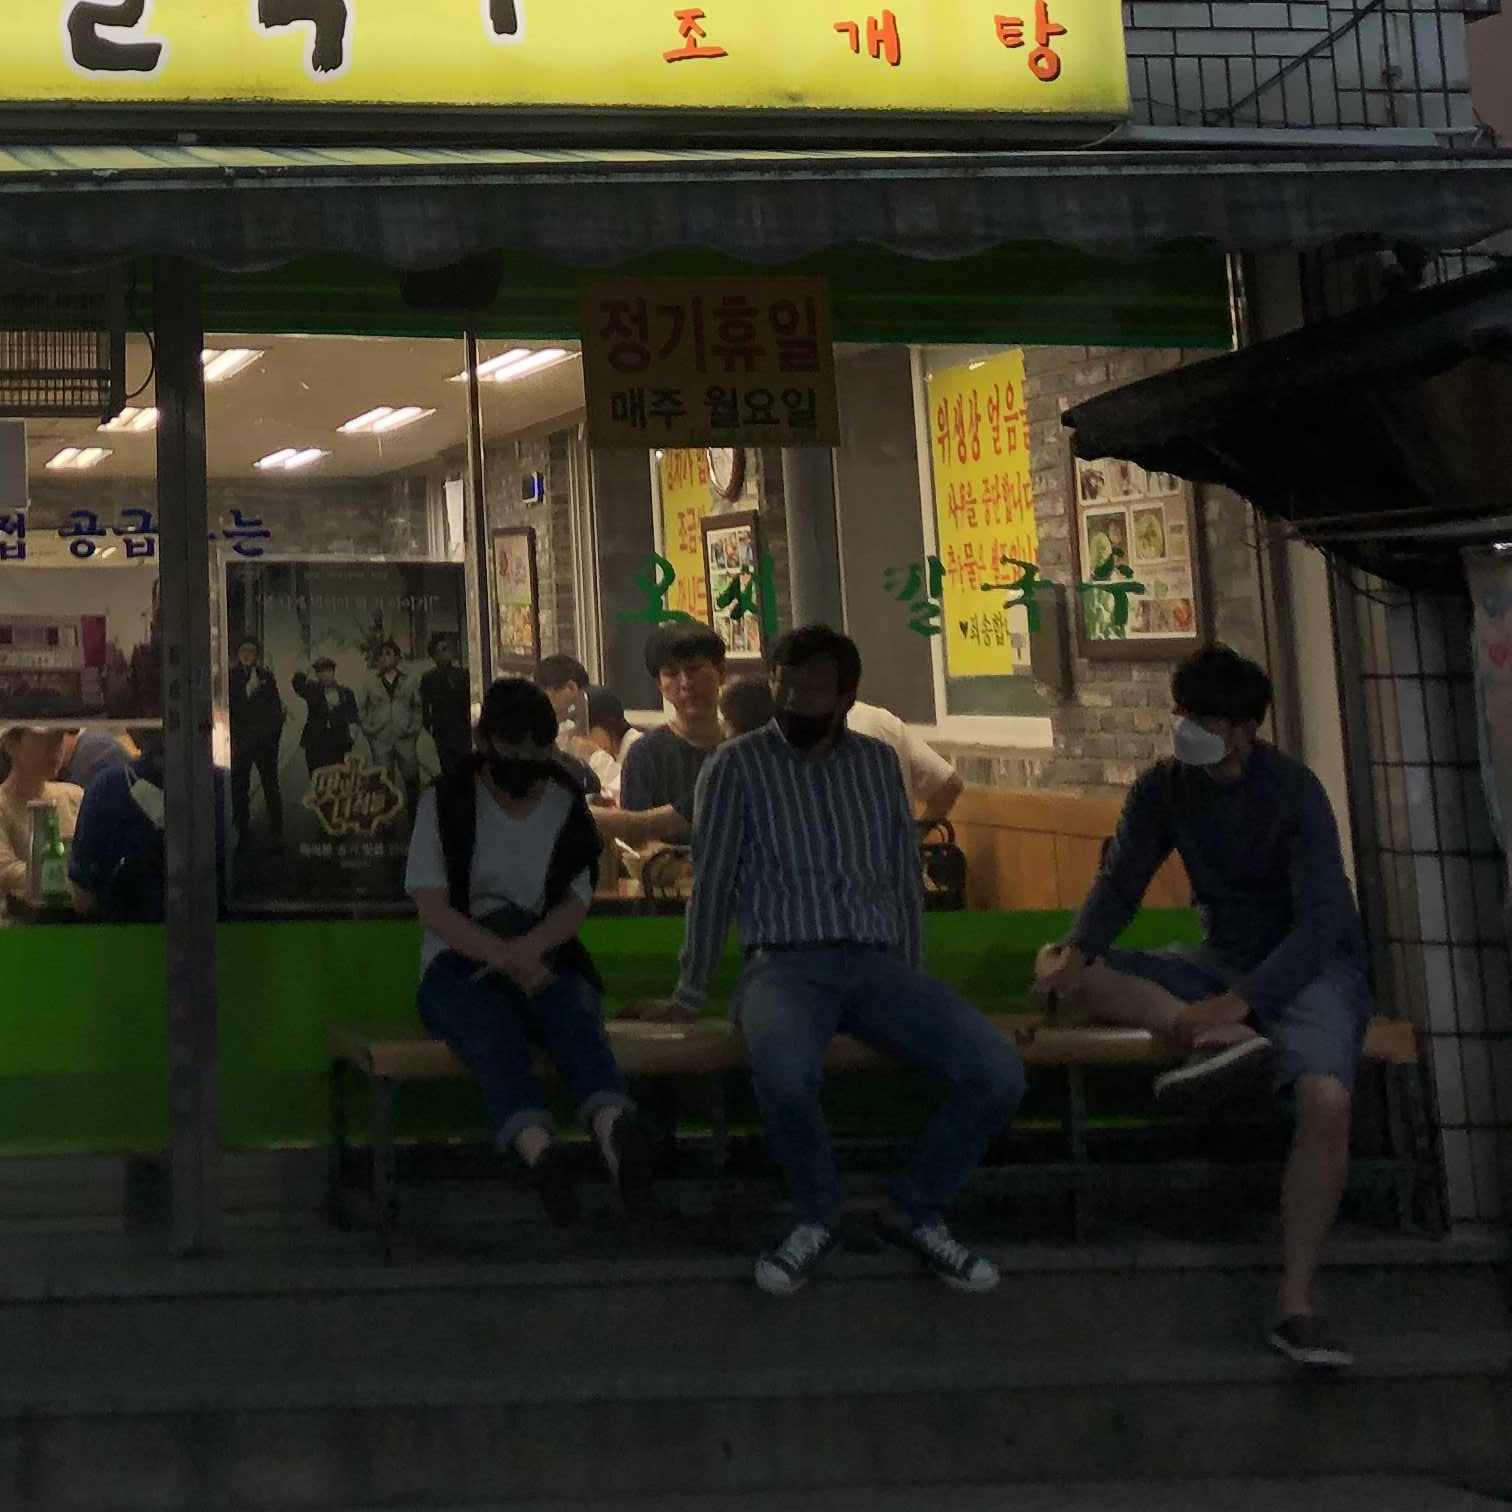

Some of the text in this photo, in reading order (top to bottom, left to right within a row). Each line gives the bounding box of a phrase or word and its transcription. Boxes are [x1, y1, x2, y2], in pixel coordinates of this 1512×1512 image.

[599, 294, 820, 374] 정기휴일
[611, 384, 817, 430] 매주 월요일
[936, 388, 982, 466] 위생상
[58, 507, 272, 557] 공급는
